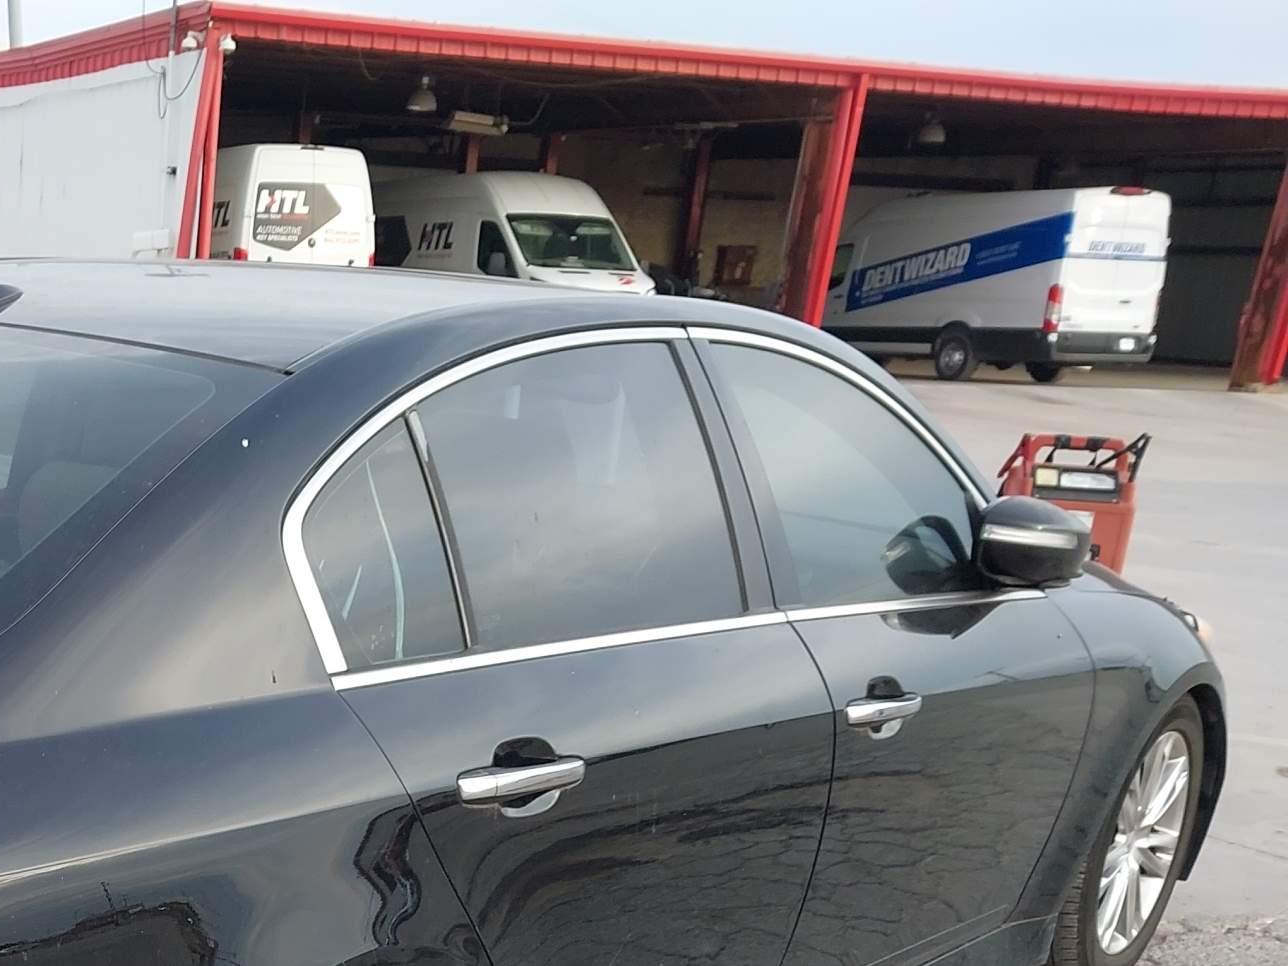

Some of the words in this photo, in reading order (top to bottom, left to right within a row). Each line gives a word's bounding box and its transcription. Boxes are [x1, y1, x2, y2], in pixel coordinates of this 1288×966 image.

[257, 189, 310, 214] HTL
[256, 224, 302, 235] AUTOMOTIVE
[418, 221, 453, 250] HTL
